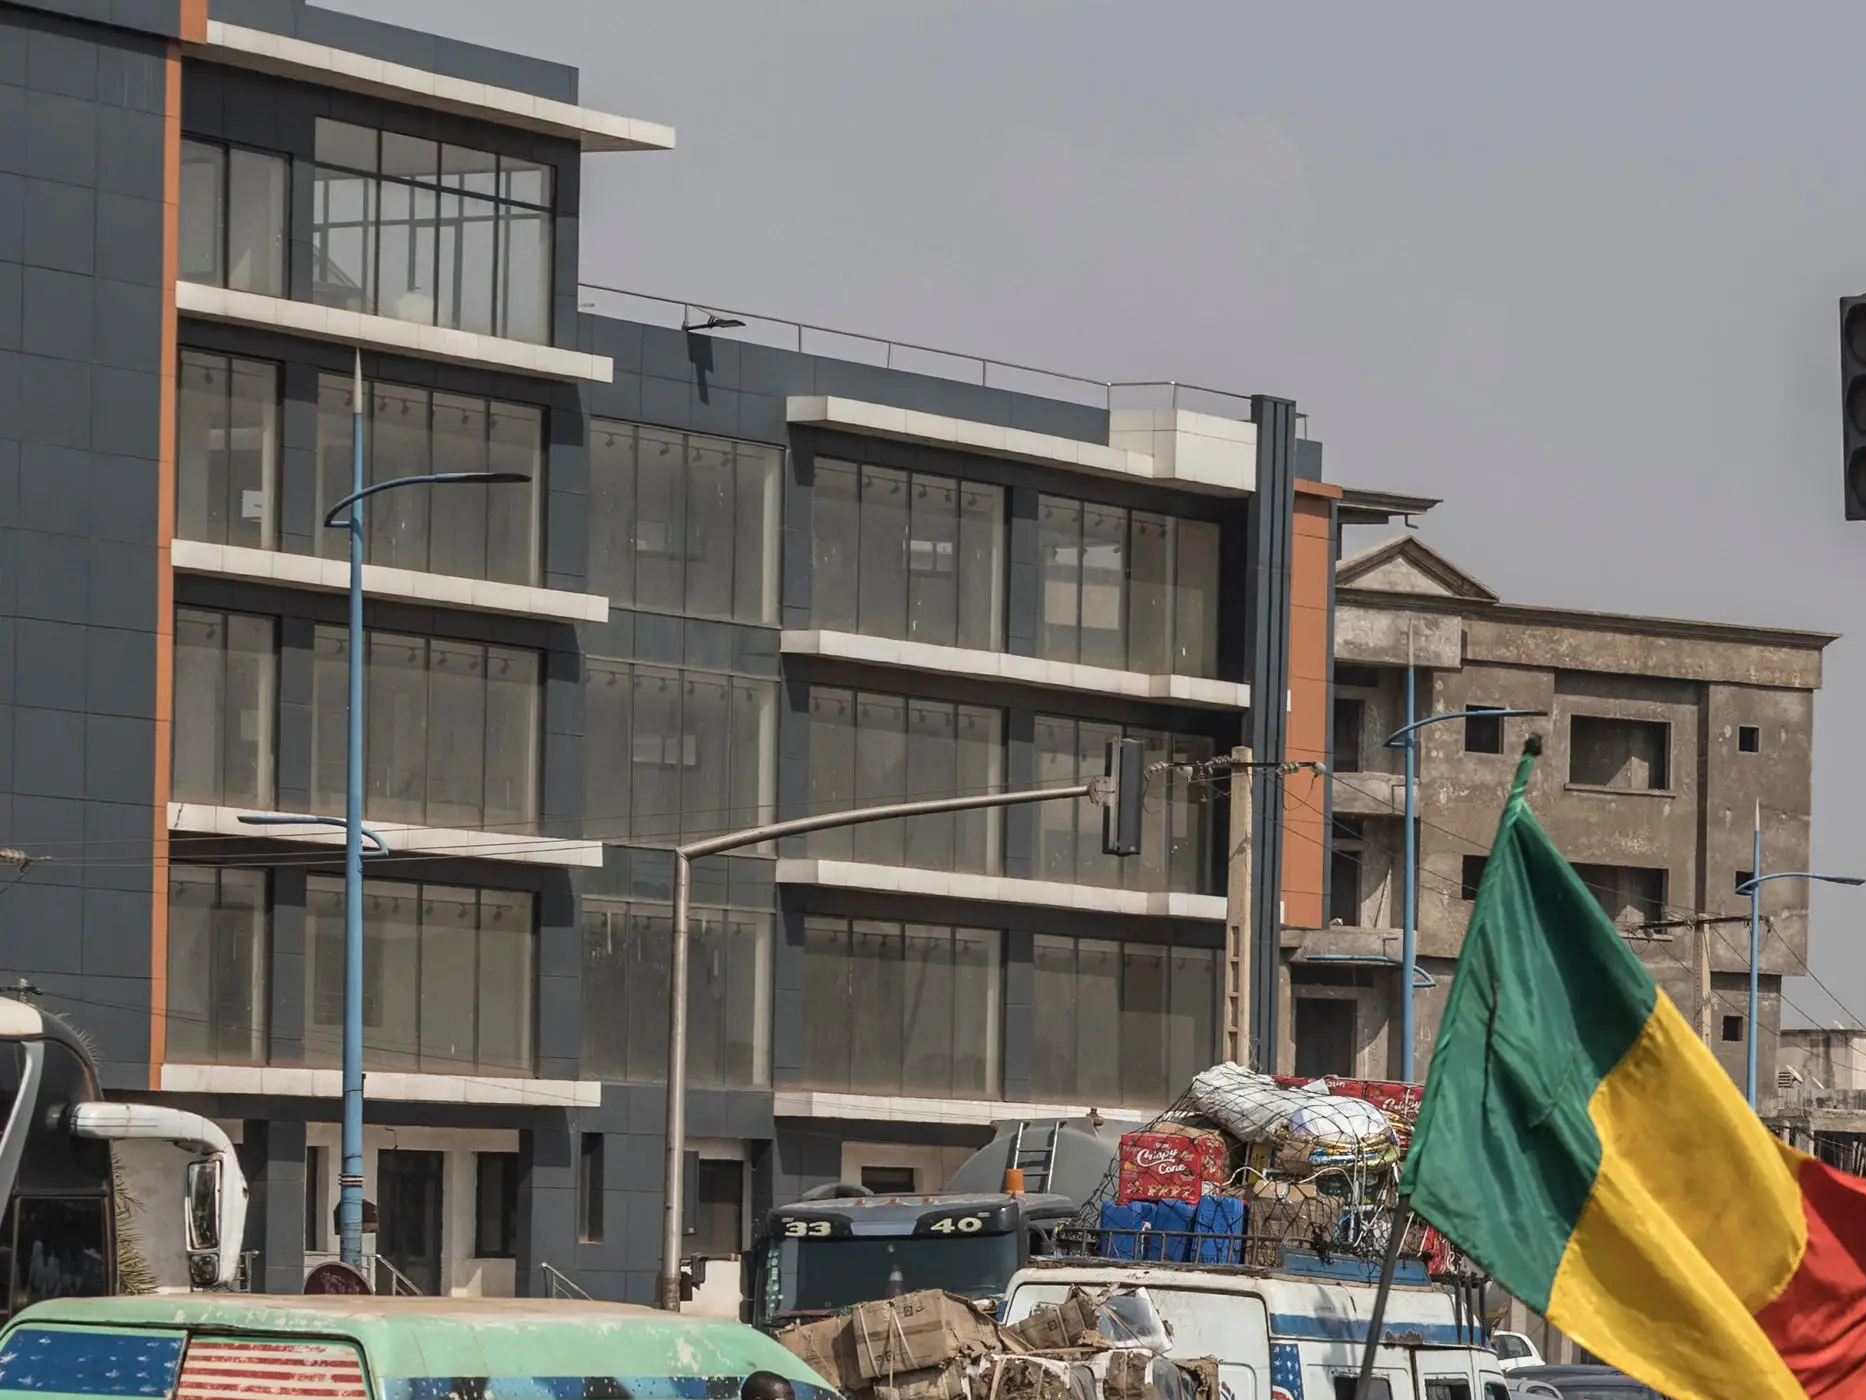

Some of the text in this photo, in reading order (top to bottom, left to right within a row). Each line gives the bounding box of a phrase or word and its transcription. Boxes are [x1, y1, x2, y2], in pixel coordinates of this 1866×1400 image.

[1137, 1149, 1178, 1167] Crispy
[1158, 1163, 1186, 1175] Cone
[785, 1221, 832, 1237] 33
[930, 1217, 983, 1233] 40
